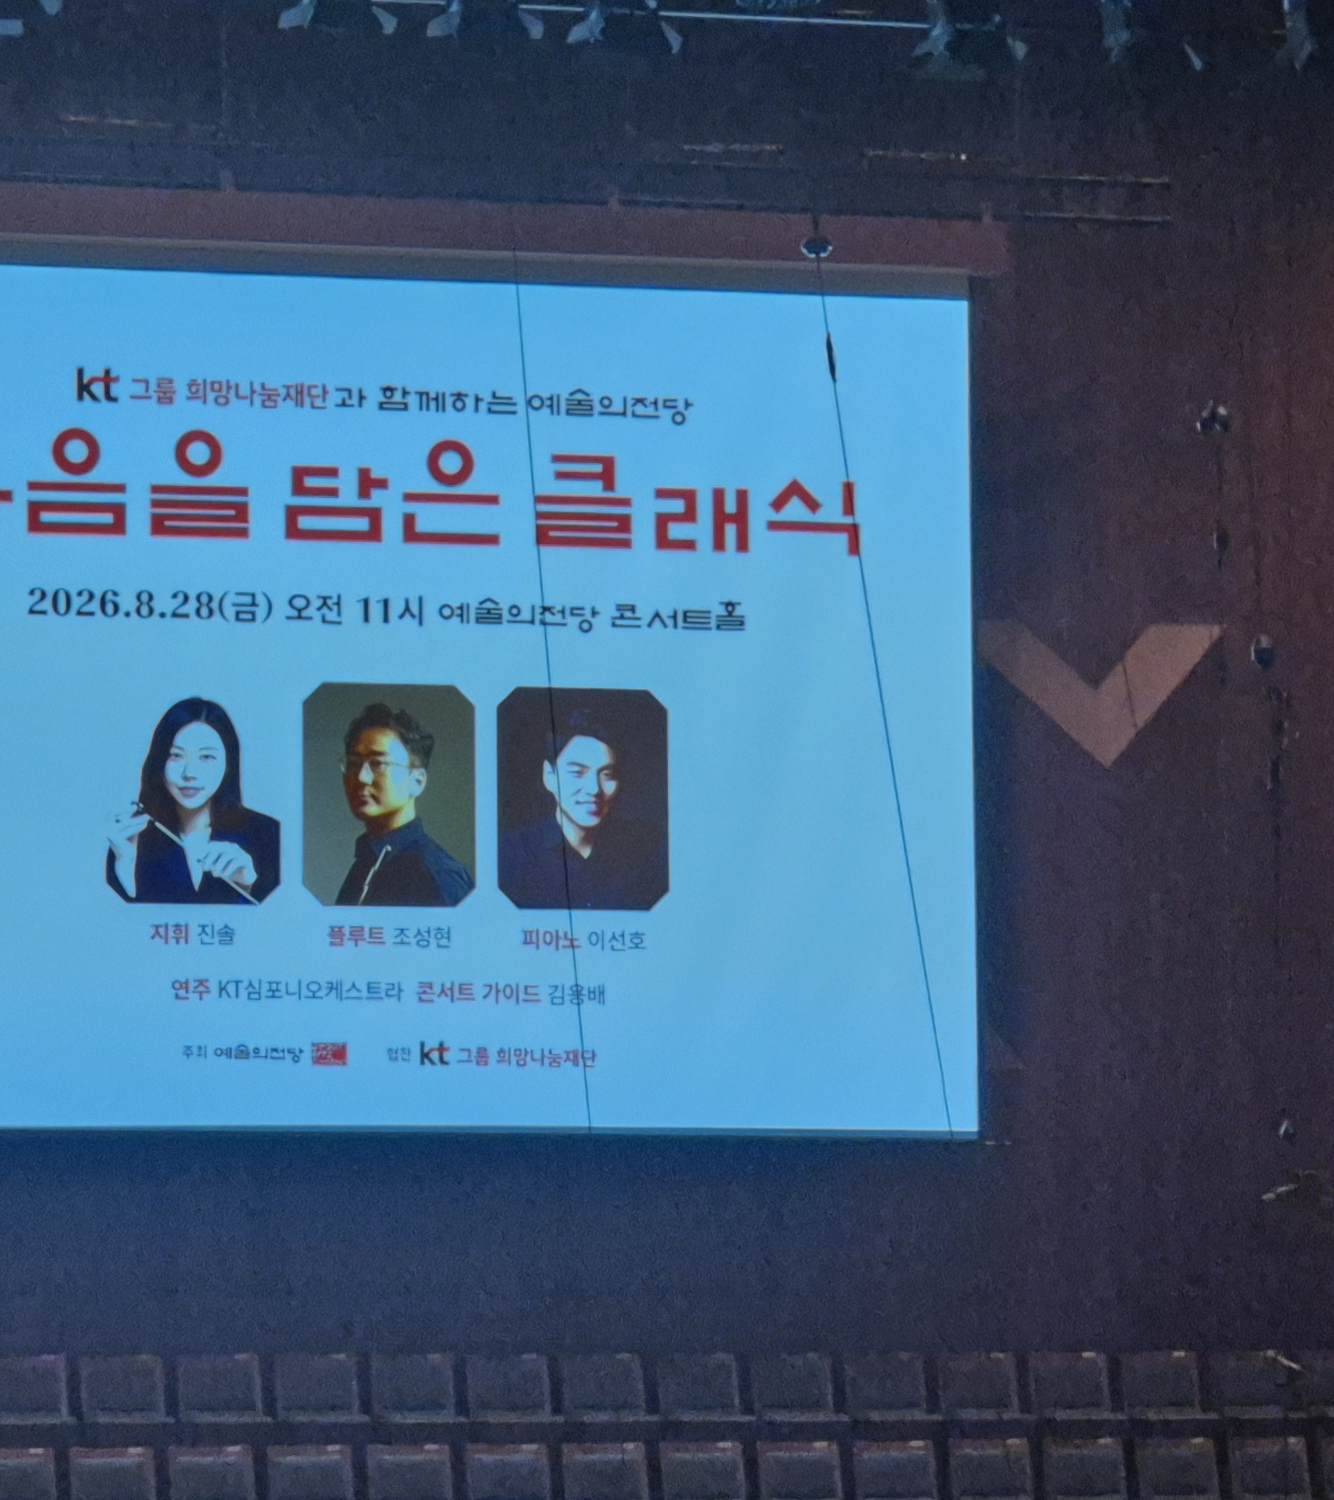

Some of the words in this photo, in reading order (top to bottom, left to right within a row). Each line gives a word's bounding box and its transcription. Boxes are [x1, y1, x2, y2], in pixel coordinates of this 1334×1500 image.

[76, 367, 119, 403] kt
[129, 377, 177, 405] 그룹
[186, 378, 367, 410] 희망나눔재단과
[377, 385, 517, 415] 함께하는
[528, 387, 693, 425] 예술의전당
[285, 439, 501, 546] 담은
[533, 453, 861, 556] 클래식
[28, 587, 273, 623] 2026.8.28(금)
[285, 594, 342, 625] 오전
[357, 596, 423, 626] 11시
[438, 597, 600, 634] 예술의전당
[611, 600, 745, 631] 콘서트홀
[150, 922, 190, 945] 지휘
[198, 924, 235, 945] 진솔
[328, 925, 386, 947] 플루트
[393, 926, 451, 949] 조성현
[522, 928, 581, 951] 피아노
[588, 930, 646, 951] 이선호
[171, 978, 211, 1001] 연주
[218, 979, 404, 1002] KT심포니오케스트라
[416, 981, 475, 1003] 콘서트
[482, 982, 541, 1005] 가이드
[549, 982, 605, 1006] 김용배
[183, 1045, 207, 1059] 주최
[420, 1041, 450, 1066] kt
[457, 1046, 490, 1067] 그룹
[496, 1047, 597, 1068] 희망나눔재단
